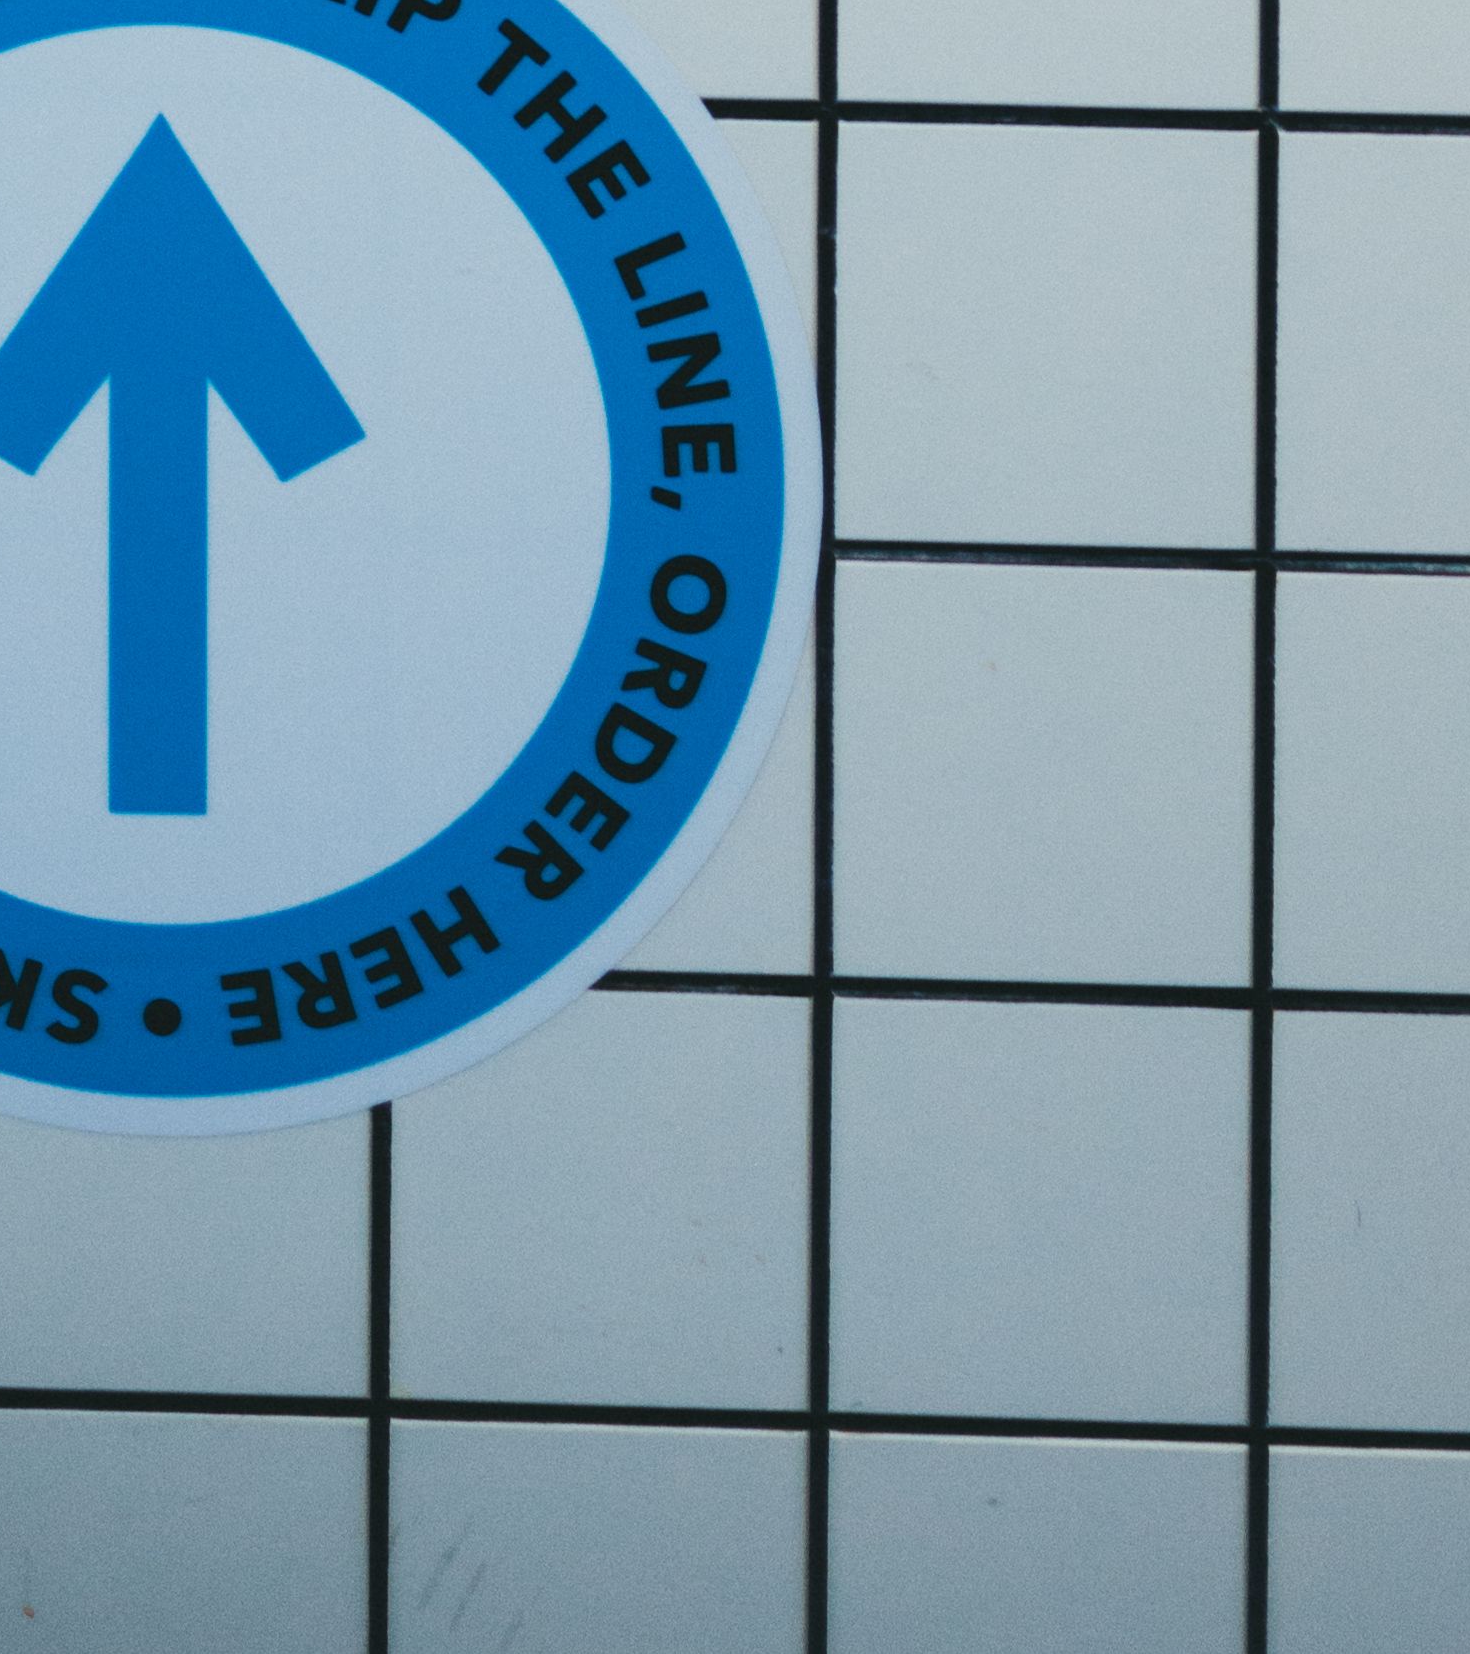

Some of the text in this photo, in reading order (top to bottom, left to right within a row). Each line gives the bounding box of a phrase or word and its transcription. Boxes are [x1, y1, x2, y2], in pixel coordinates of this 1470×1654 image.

[476, 18, 651, 220] THE
[613, 231, 738, 511] LINE,
[493, 553, 728, 902] ORDER
[219, 885, 502, 1048] HERE
